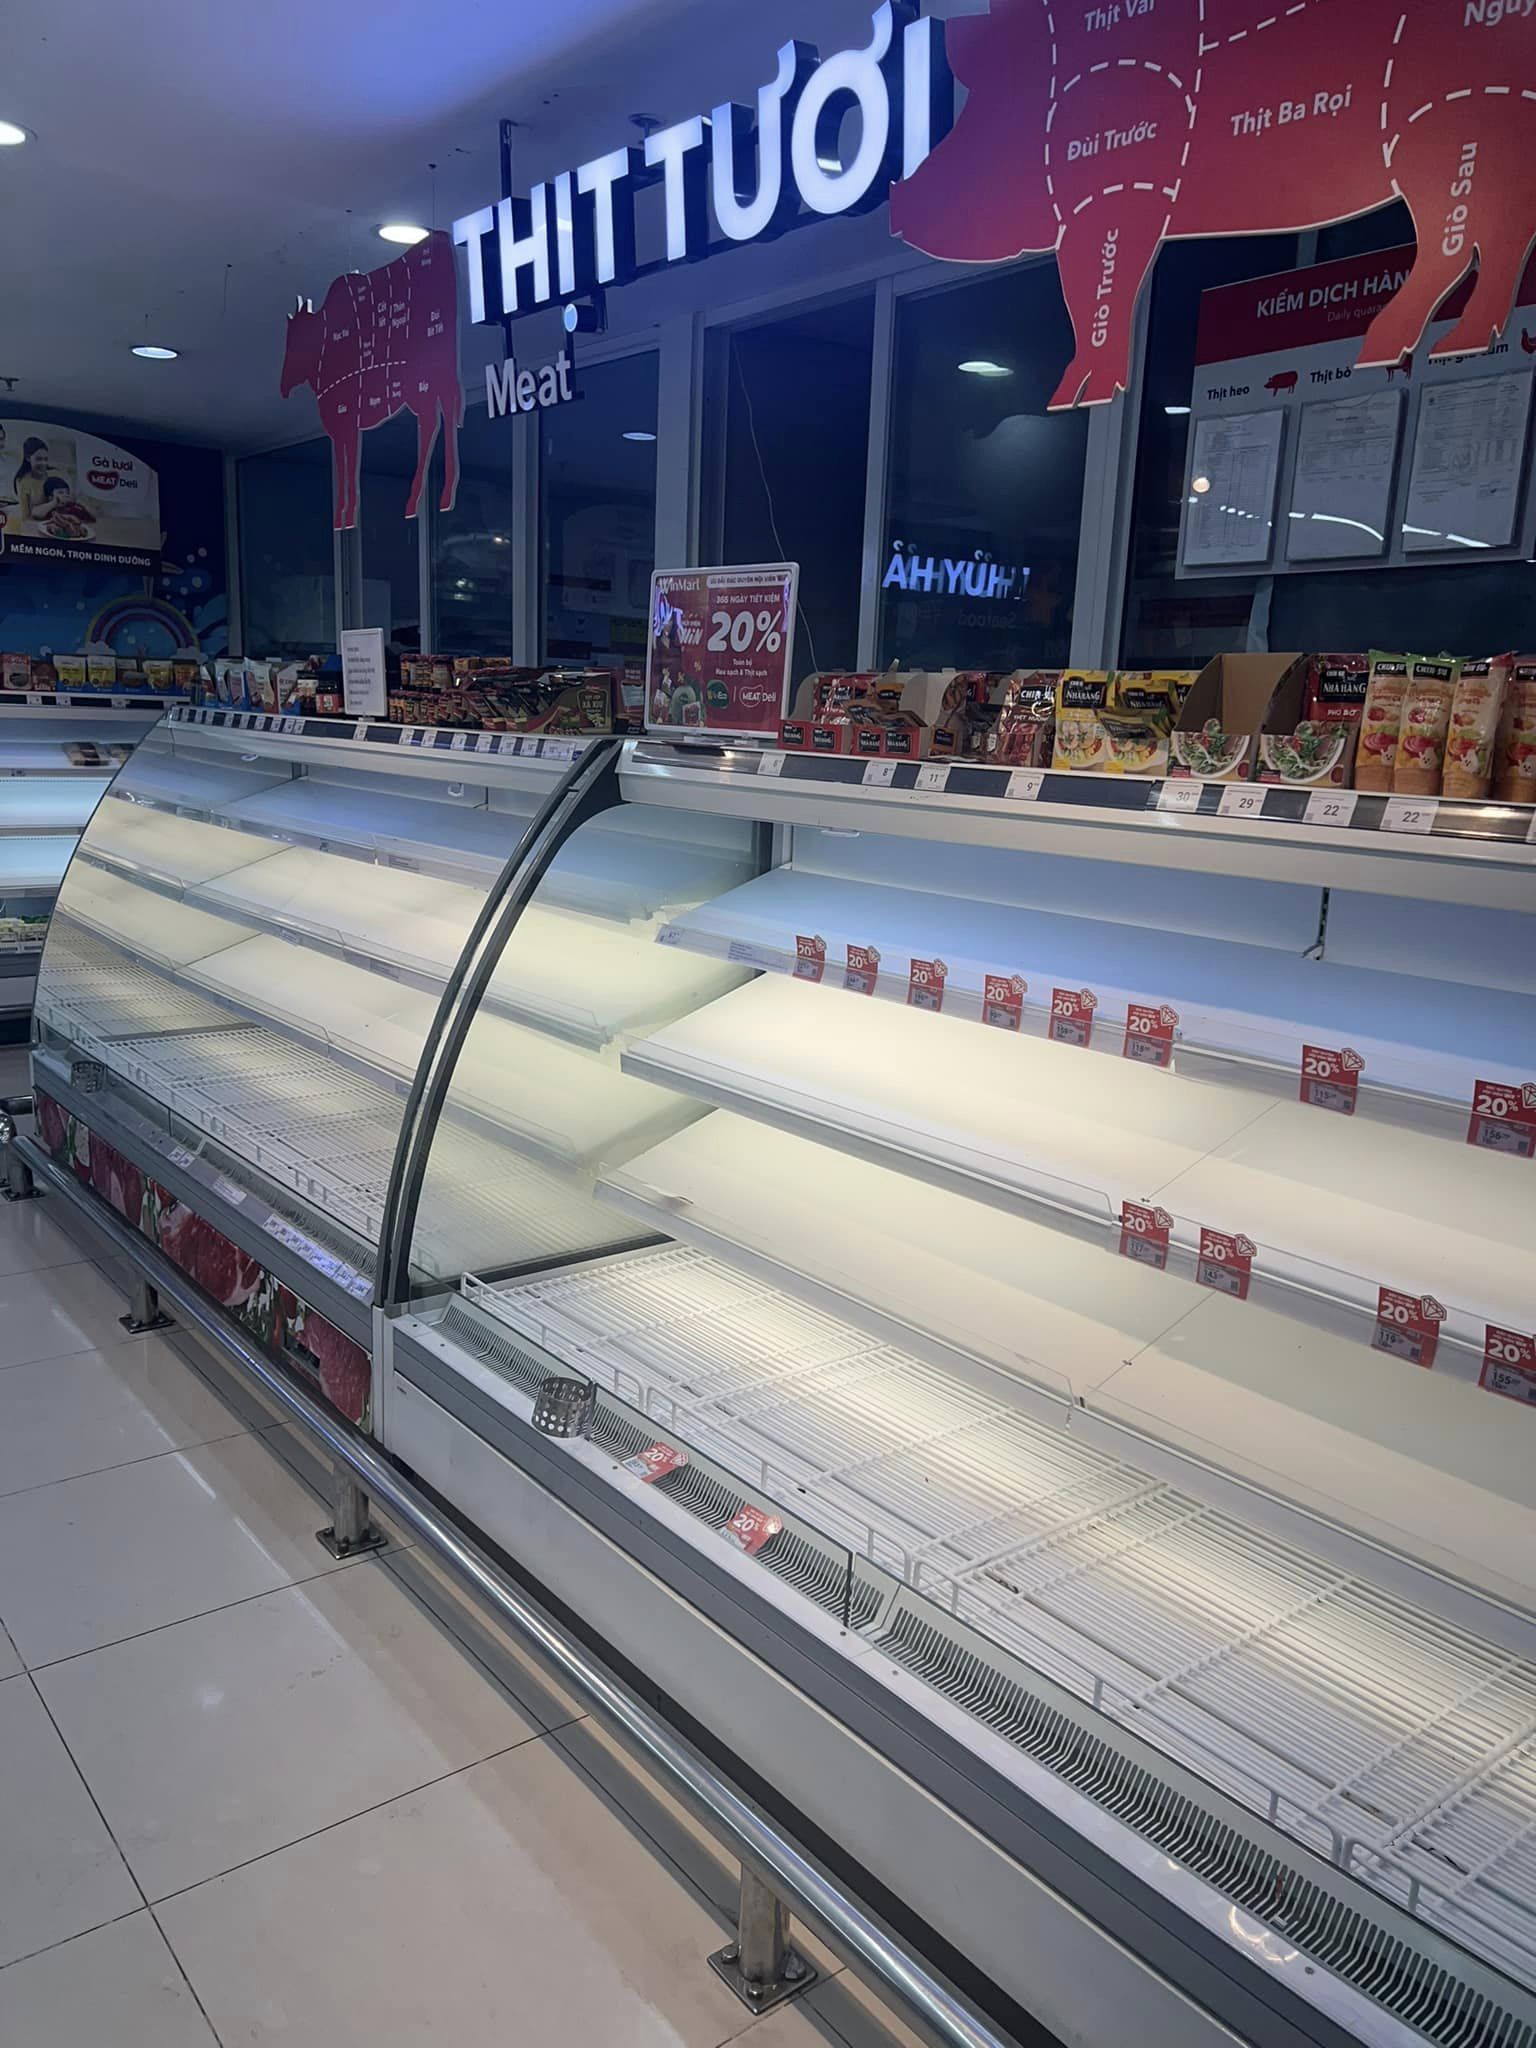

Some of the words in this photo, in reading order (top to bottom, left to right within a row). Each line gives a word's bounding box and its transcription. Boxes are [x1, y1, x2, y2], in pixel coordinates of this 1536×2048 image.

[1085, 5, 1120, 32] Thịt
[1230, 109, 1271, 137] Thịt
[1277, 100, 1307, 125] Ba
[1312, 84, 1353, 118] Rọi
[1067, 133, 1099, 161] Đùi
[1104, 120, 1158, 153] Trước
[453, 146, 629, 333] THỊT
[644, 0, 931, 262] TƯƠI
[1450, 141, 1478, 198] Sau
[1442, 203, 1468, 257] Giò
[1096, 227, 1120, 297] Trước
[1256, 287, 1305, 319] KIỂM
[1308, 280, 1359, 310] DỊCH
[1090, 300, 1112, 348] Giò
[1327, 309, 1351, 322] Daily
[485, 350, 573, 419] Meat
[1310, 370, 1333, 385] Thịt
[1335, 366, 1352, 380] bò
[1207, 387, 1227, 402] Thịt
[1229, 384, 1250, 397] heo
[92, 456, 110, 468] Gà
[112, 459, 133, 471] tươi
[91, 474, 117, 486] MEAT
[119, 478, 138, 489] Deli
[67, 549, 92, 561] TRỌN
[93, 551, 117, 563] DINH
[656, 576, 701, 595] WinMart
[707, 610, 782, 653] 20%
[742, 691, 761, 701] MEAT
[762, 691, 777, 702] Deli
[1176, 791, 1190, 801] 30
[1239, 798, 1254, 809] 29
[1323, 804, 1340, 816] 22
[1402, 811, 1420, 823] 22
[799, 943, 816, 958] 20%
[848, 955, 868, 969] 20%
[912, 969, 934, 985] 20%
[986, 985, 1010, 1001] 20%
[1053, 1000, 1079, 1017] 20%
[1129, 1016, 1158, 1034] 20%
[1304, 1057, 1339, 1078] 20%
[1476, 1095, 1519, 1117] 20%
[1124, 1213, 1153, 1233] 20%
[1203, 1240, 1234, 1261] 20%
[1380, 1301, 1419, 1324] 20%
[1487, 1338, 1532, 1363] 20%
[643, 1448, 668, 1463] 20%
[732, 1513, 760, 1532] 20%
